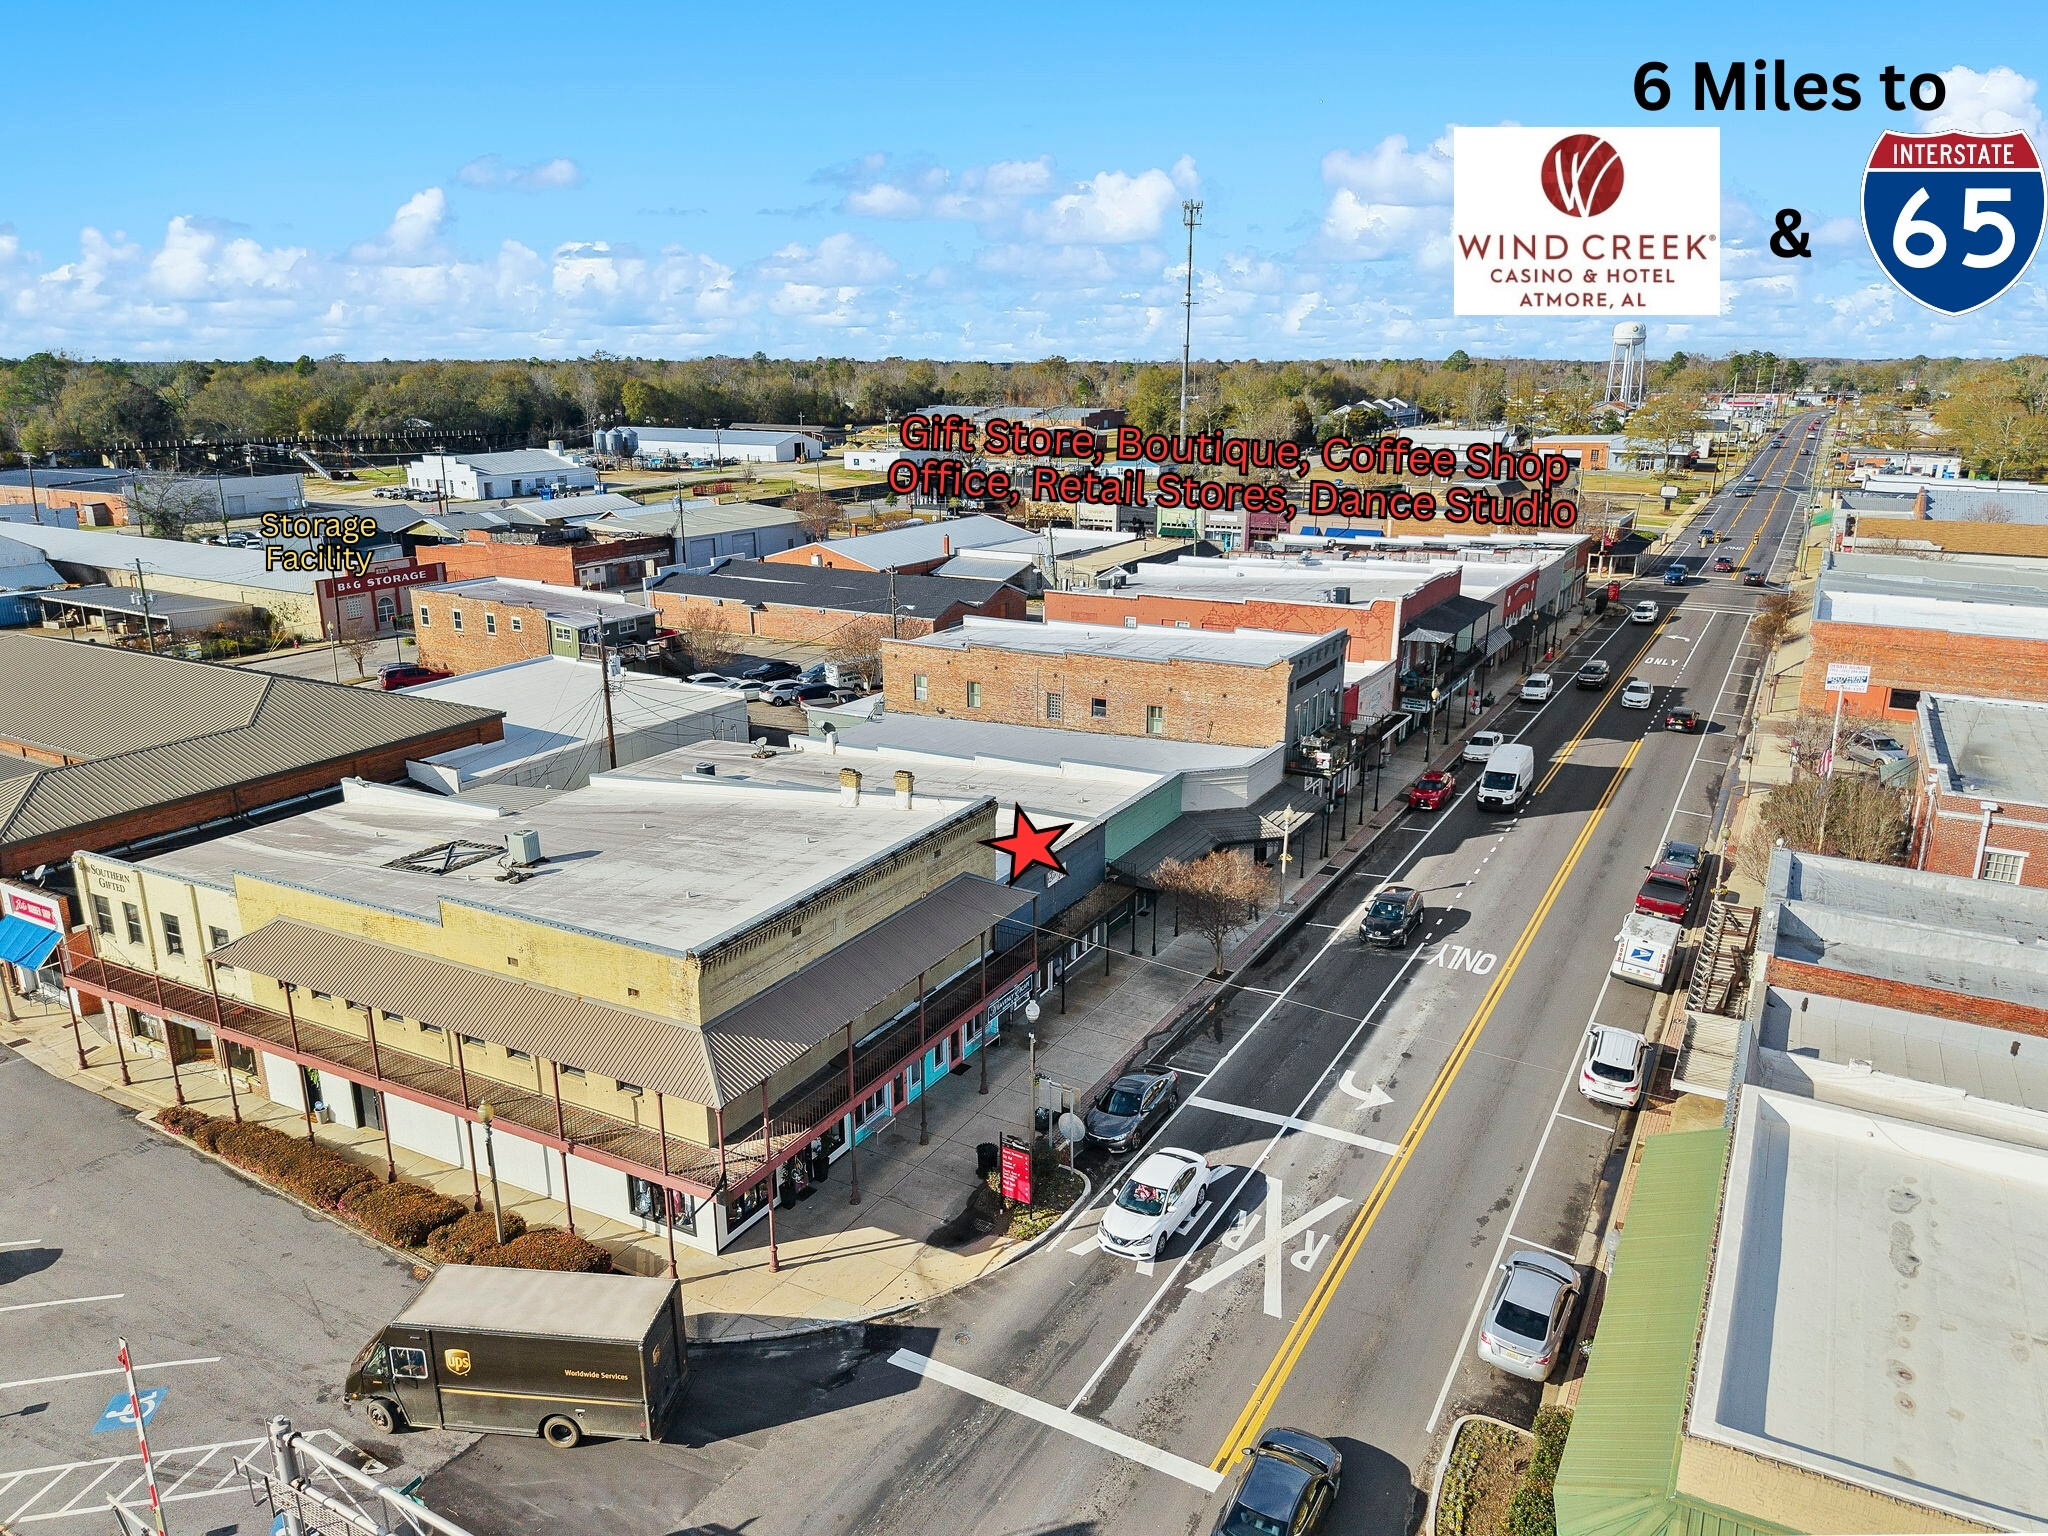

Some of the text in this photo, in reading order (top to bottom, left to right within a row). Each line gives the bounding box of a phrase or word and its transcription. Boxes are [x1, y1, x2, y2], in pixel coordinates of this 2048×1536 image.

[337, 580, 361, 592] B&G
[366, 570, 427, 588] STORAGE
[1644, 657, 1678, 667] ONLY
[90, 863, 130, 883] SOUTHERN
[98, 877, 126, 893] GIFTED
[1426, 943, 1498, 974] ONLY
[1291, 1229, 1331, 1272] R
[446, 1356, 469, 1371] ups
[564, 1369, 629, 1381] Worldwide Services
